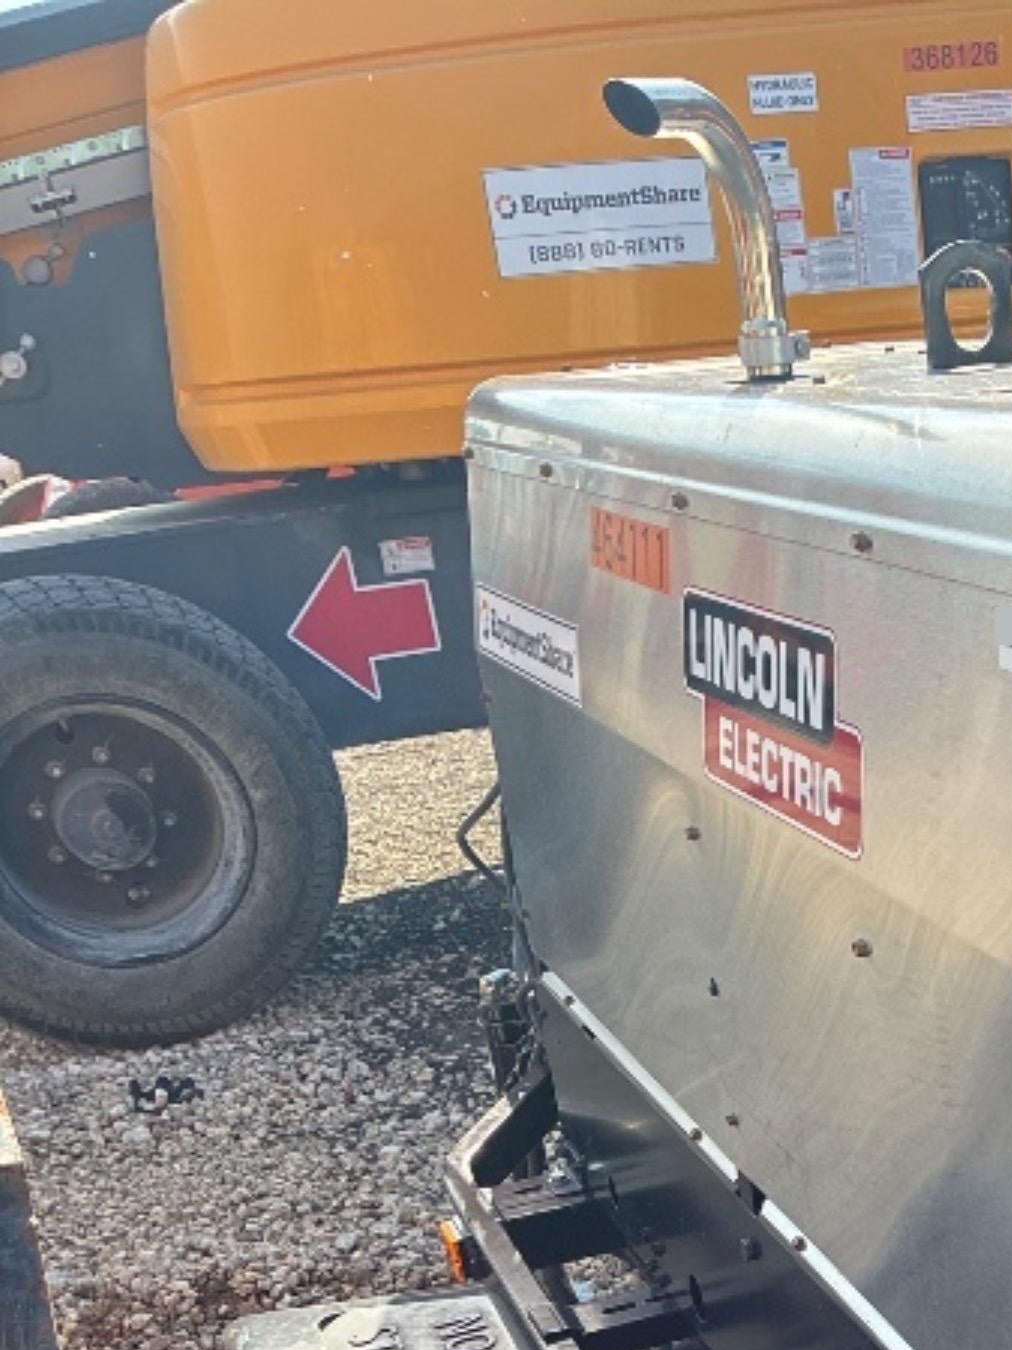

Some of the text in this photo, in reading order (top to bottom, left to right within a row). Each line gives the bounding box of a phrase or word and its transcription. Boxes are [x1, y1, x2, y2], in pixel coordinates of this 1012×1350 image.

[911, 42, 998, 70] 368126
[521, 185, 701, 217] EquipmentShare
[689, 608, 826, 731] LINCOLN
[719, 715, 843, 826] ELECTRIC
